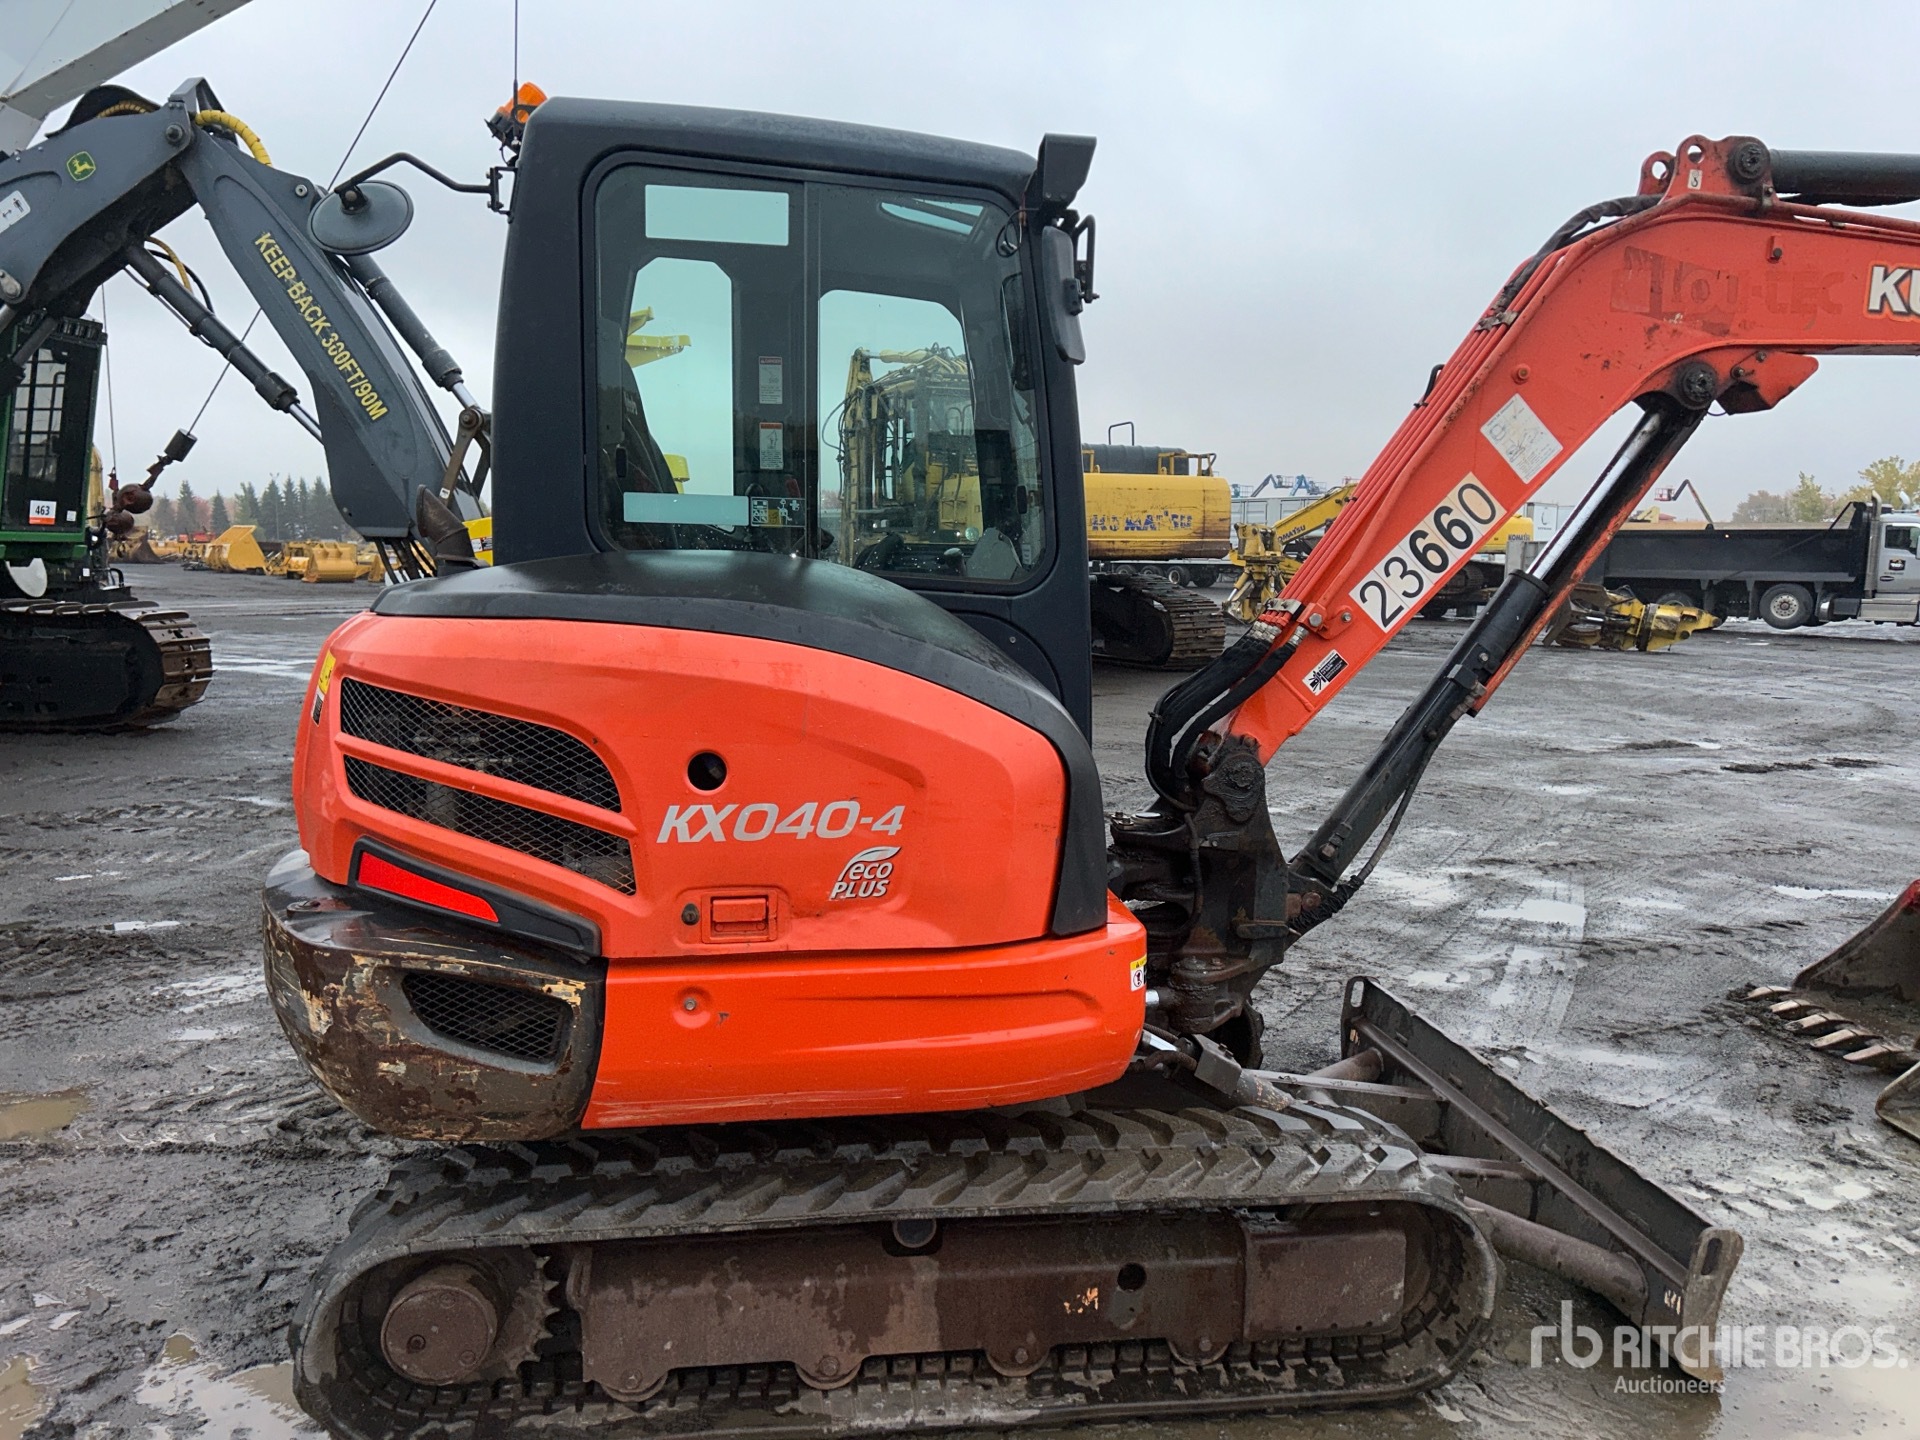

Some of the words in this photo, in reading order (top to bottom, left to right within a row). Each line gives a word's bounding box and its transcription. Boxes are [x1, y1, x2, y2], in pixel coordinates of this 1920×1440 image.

[255, 232, 297, 282] KEEP
[287, 281, 332, 336] BACK
[321, 332, 389, 421] 300FT/90M
[35, 505, 50, 515] 463
[1359, 483, 1496, 628] 23660
[656, 800, 905, 843] KX040-4
[848, 862, 893, 881] eco
[829, 879, 890, 900] PLUS
